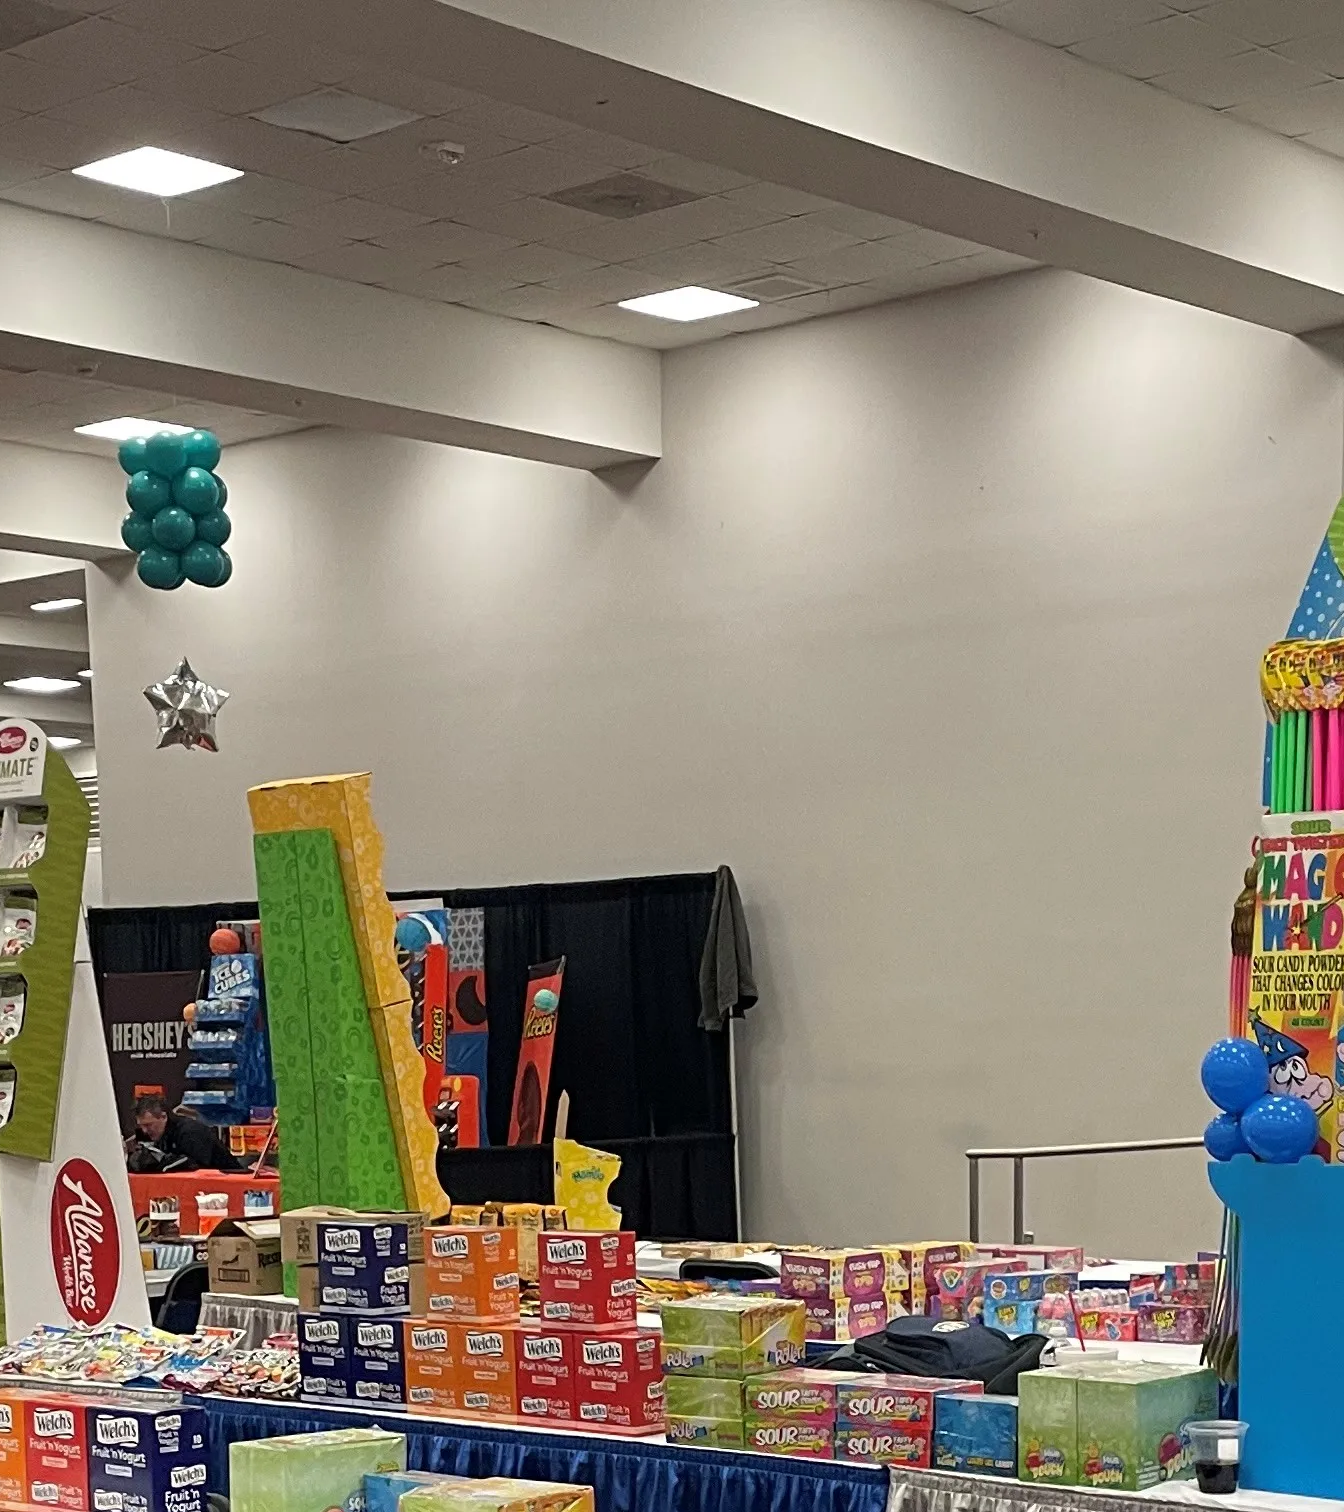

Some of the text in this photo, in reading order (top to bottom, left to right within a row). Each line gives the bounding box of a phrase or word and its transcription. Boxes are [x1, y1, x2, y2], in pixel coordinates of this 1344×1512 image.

[1291, 819, 1332, 835] SOUR
[1262, 902, 1344, 952] WAND
[1253, 955, 1306, 974] SOUR CANDY
[213, 969, 252, 994] CUBES
[1252, 974, 1313, 992] THAT CHANGES
[1262, 993, 1331, 1012] IN YOUR MOUTH
[61, 1173, 104, 1315] Albanese
[327, 1233, 358, 1247] Welch's
[434, 1239, 466, 1252] Welch's
[549, 1244, 584, 1259] Welch's
[542, 1265, 593, 1278] Fruit Yogurt
[307, 1324, 338, 1338] Welch's
[361, 1328, 391, 1342] Welch's
[415, 1332, 446, 1346] Welch's
[468, 1337, 502, 1351] Welch's
[526, 1342, 560, 1356] Welch's
[586, 1346, 620, 1360] Welch's
[757, 1389, 800, 1409] SOUR
[848, 1396, 895, 1416] SOUR
[36, 1414, 72, 1432] Welch's
[99, 1422, 137, 1439] Welch's
[193, 1434, 202, 1444] 10
[755, 1427, 798, 1446] SOUR
[29, 1438, 80, 1456] Fruit Yogurt
[848, 1435, 894, 1455] SOUR
[92, 1445, 146, 1464] Fruit Yogurt
[173, 1468, 205, 1483] Welch's
[165, 1489, 200, 1502] Fruit 'n
